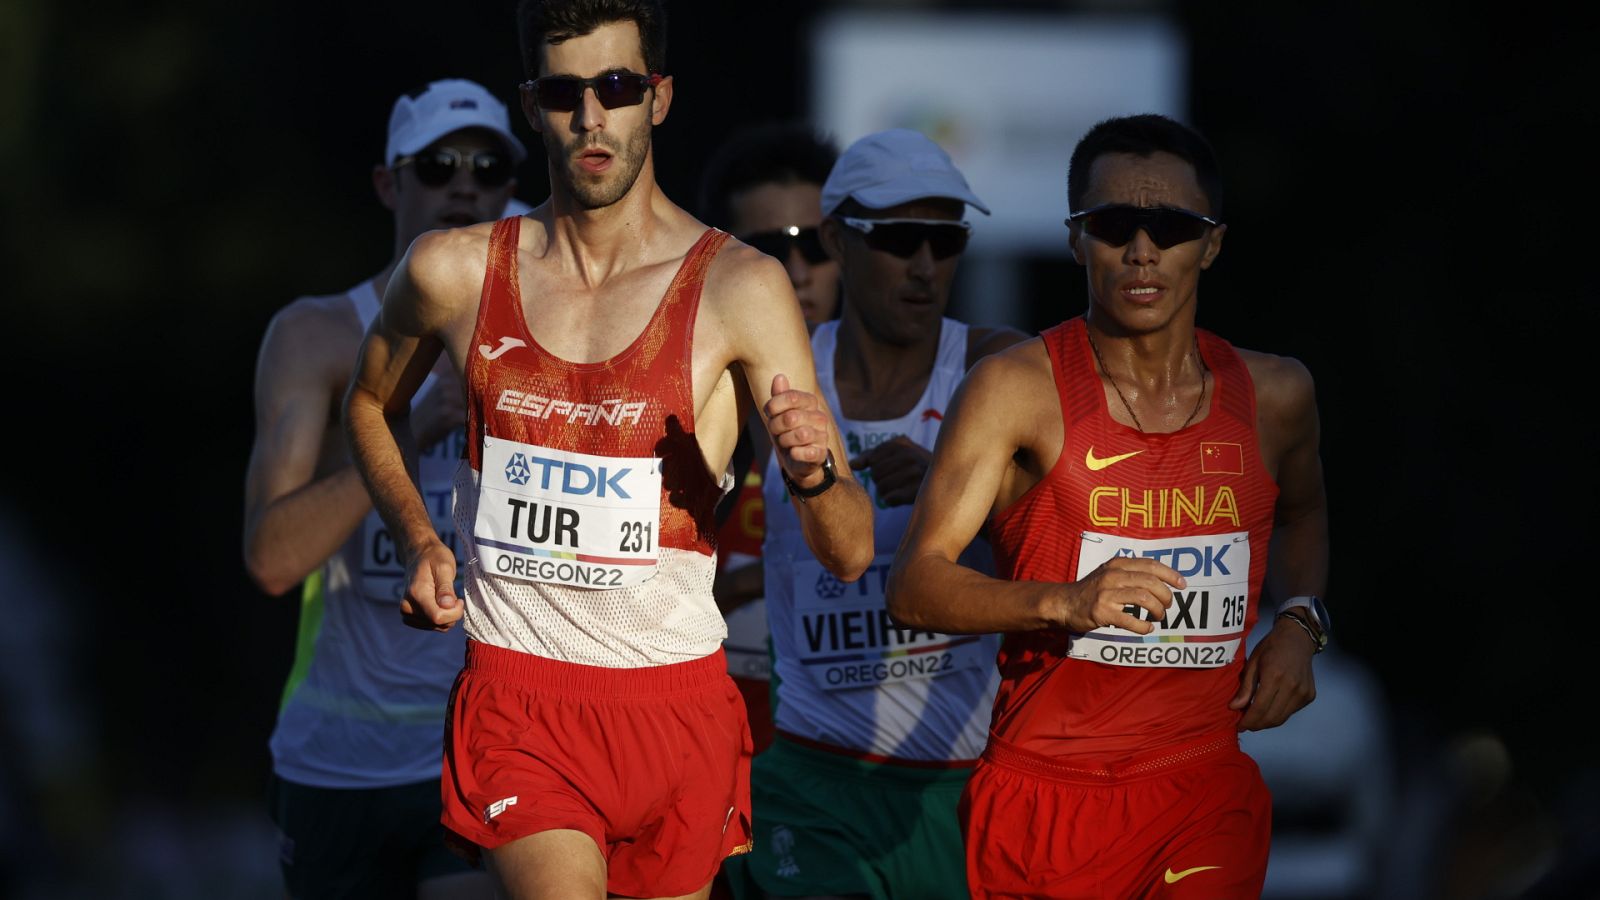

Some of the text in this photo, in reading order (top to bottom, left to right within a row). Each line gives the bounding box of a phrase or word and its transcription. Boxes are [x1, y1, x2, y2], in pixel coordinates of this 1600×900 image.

[496, 389, 647, 426] ESPAÑA
[531, 456, 632, 499] TDK
[1088, 485, 1241, 529] CHINA
[508, 498, 580, 549] TUR
[619, 521, 652, 553] 231
[496, 554, 623, 586] OREGON22
[1141, 544, 1231, 578] TDK
[1222, 595, 1245, 628] 215
[826, 653, 953, 684] OREGON22
[1100, 645, 1226, 665] OREGON22
